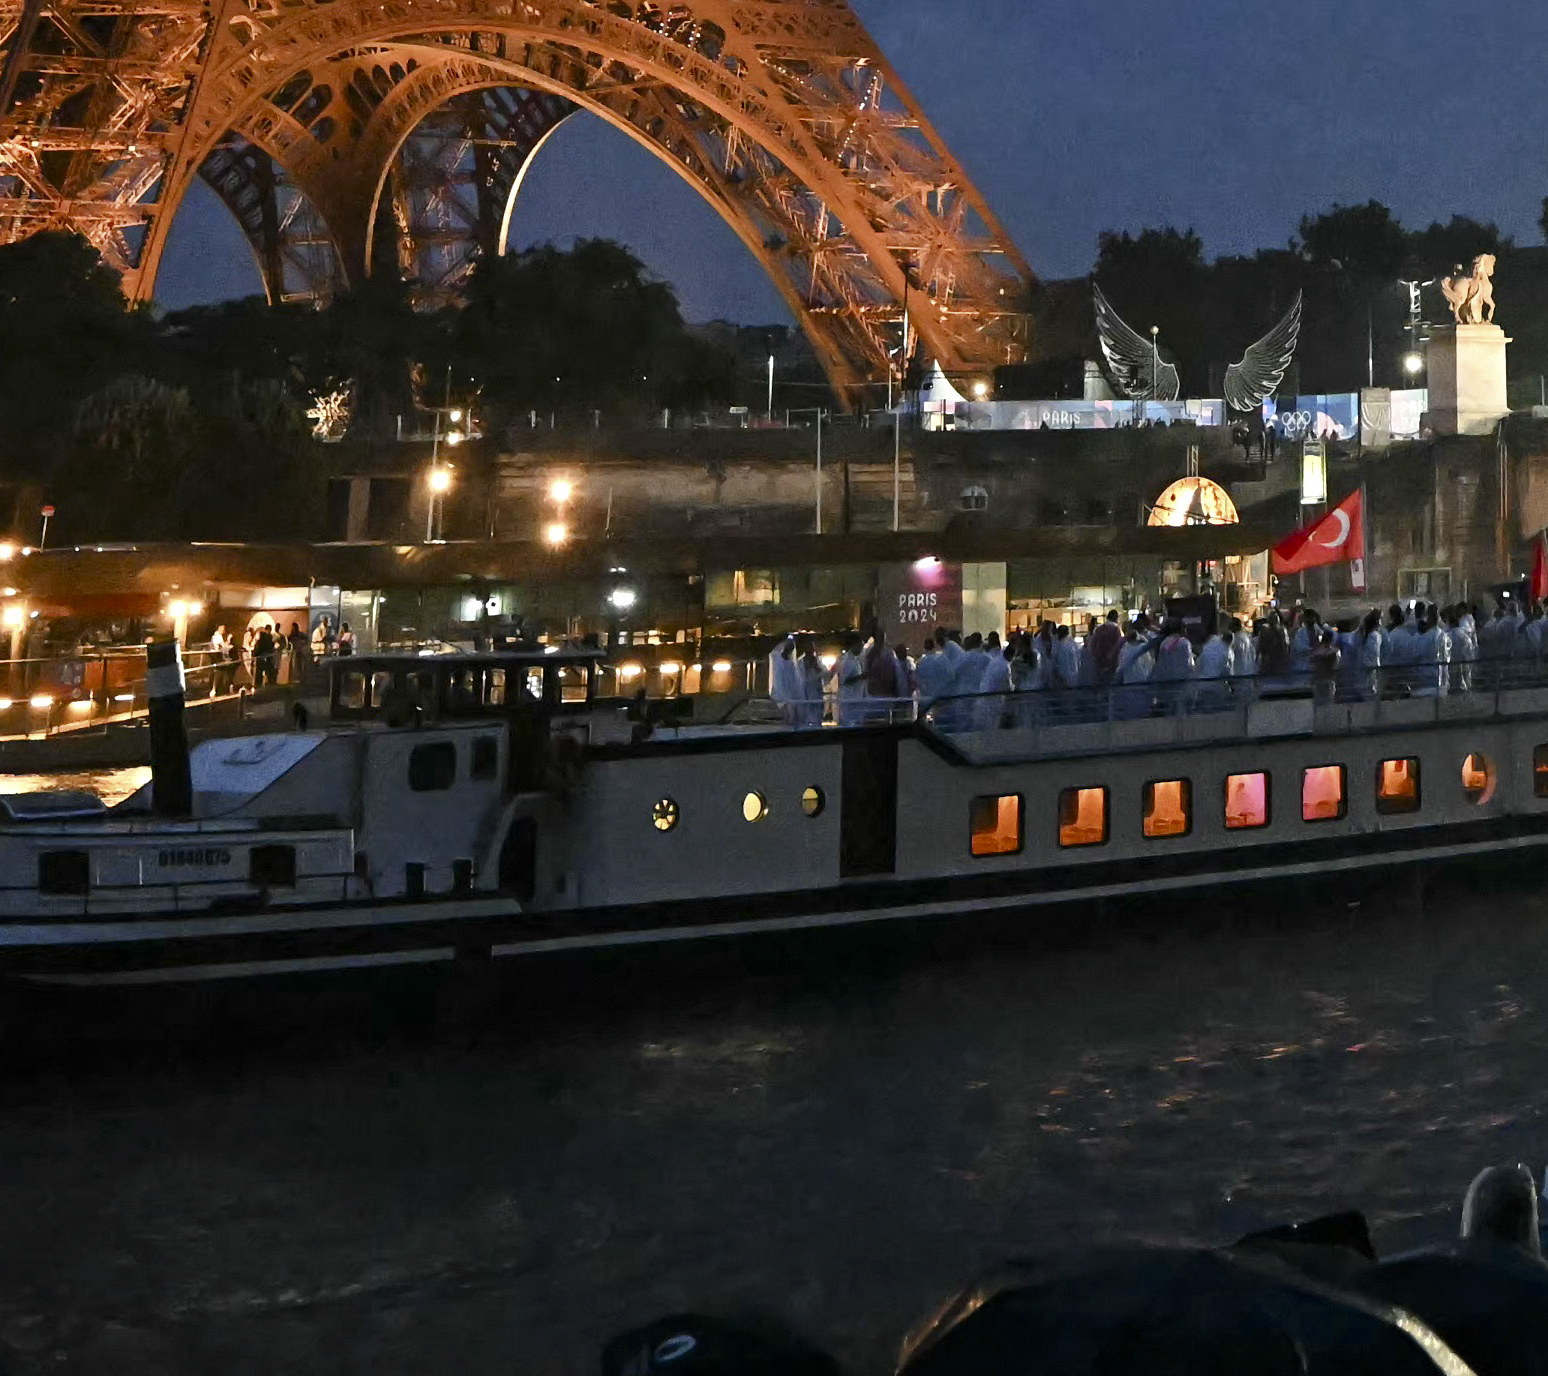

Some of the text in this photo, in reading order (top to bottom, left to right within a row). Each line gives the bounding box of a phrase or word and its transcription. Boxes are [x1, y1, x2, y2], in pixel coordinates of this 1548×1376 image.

[1042, 410, 1081, 425] PARIS
[899, 592, 937, 607] PARIS
[899, 608, 937, 623] 2024
